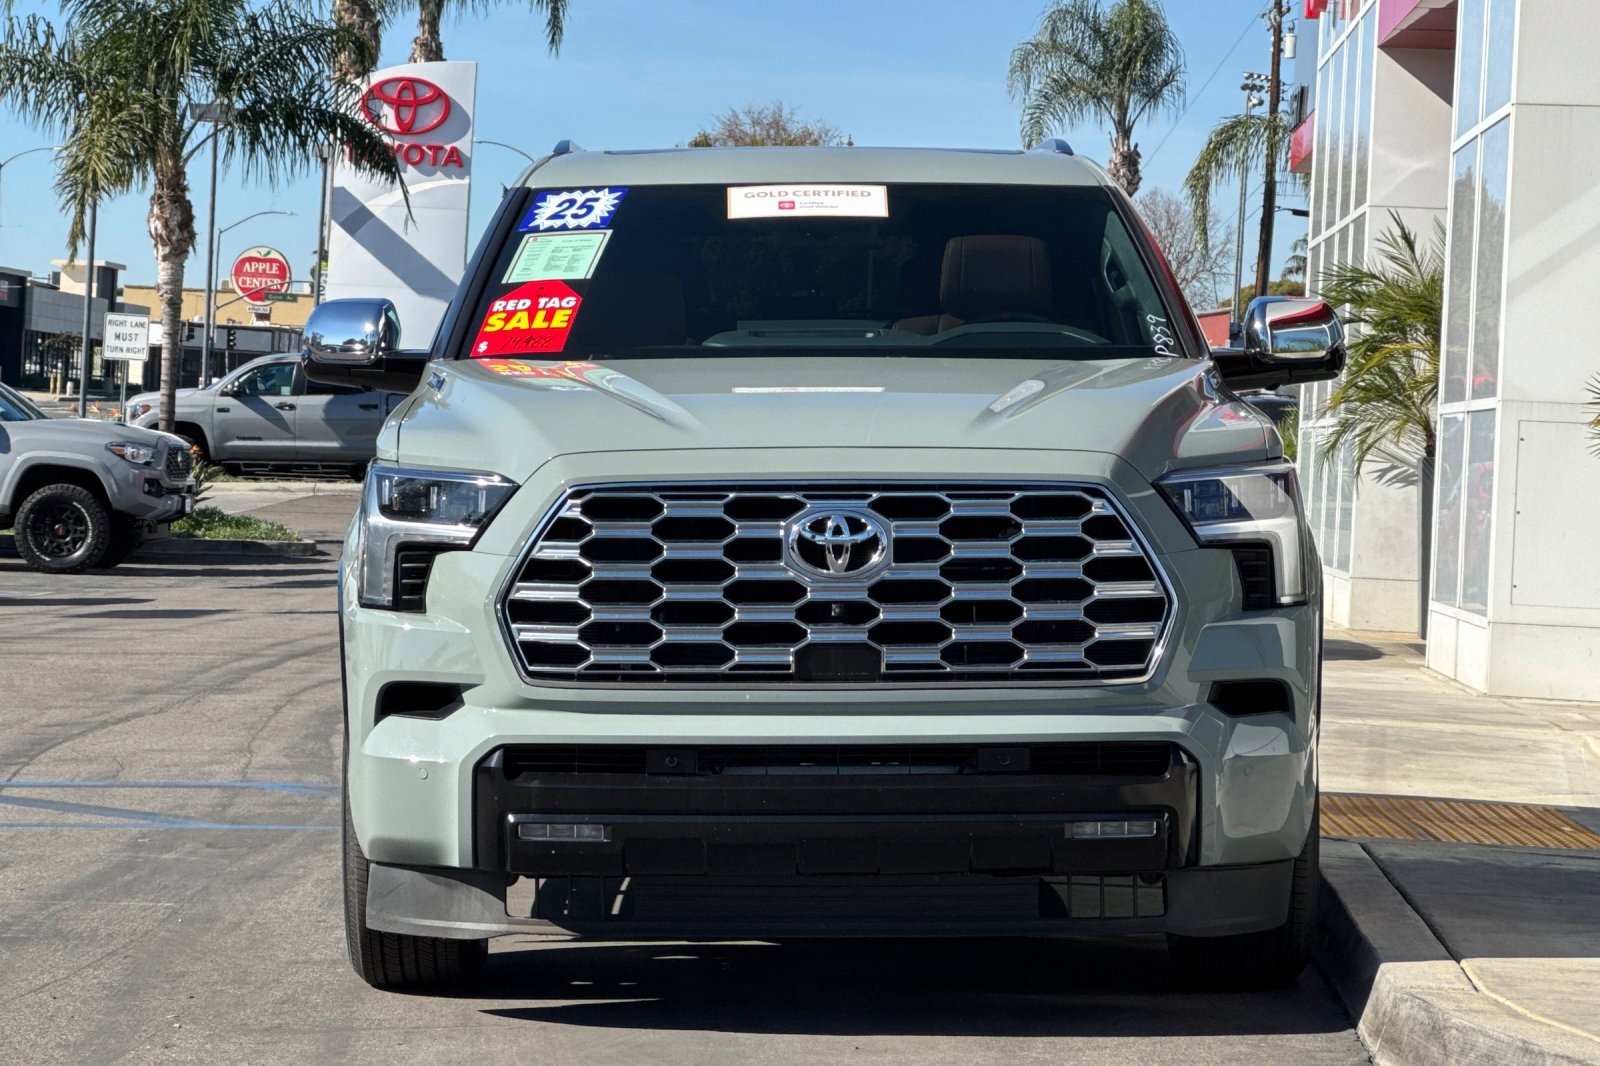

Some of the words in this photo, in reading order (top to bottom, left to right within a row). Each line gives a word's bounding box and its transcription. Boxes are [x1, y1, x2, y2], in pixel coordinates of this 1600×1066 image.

[344, 141, 463, 168] YOTA
[744, 190, 789, 199] GOLD
[793, 190, 872, 198] CERTIFIED
[545, 197, 602, 221] 25
[243, 261, 280, 275] APPLE
[238, 276, 281, 290] CENTER
[492, 299, 531, 312] RED
[538, 296, 577, 309] TAG
[107, 319, 128, 327] RIGHT
[130, 320, 147, 329] LANE
[483, 309, 572, 332] SALE
[114, 332, 139, 342] MUST
[106, 345, 124, 353] TURN
[125, 347, 146, 355] RIGHT
[477, 341, 488, 353] $
